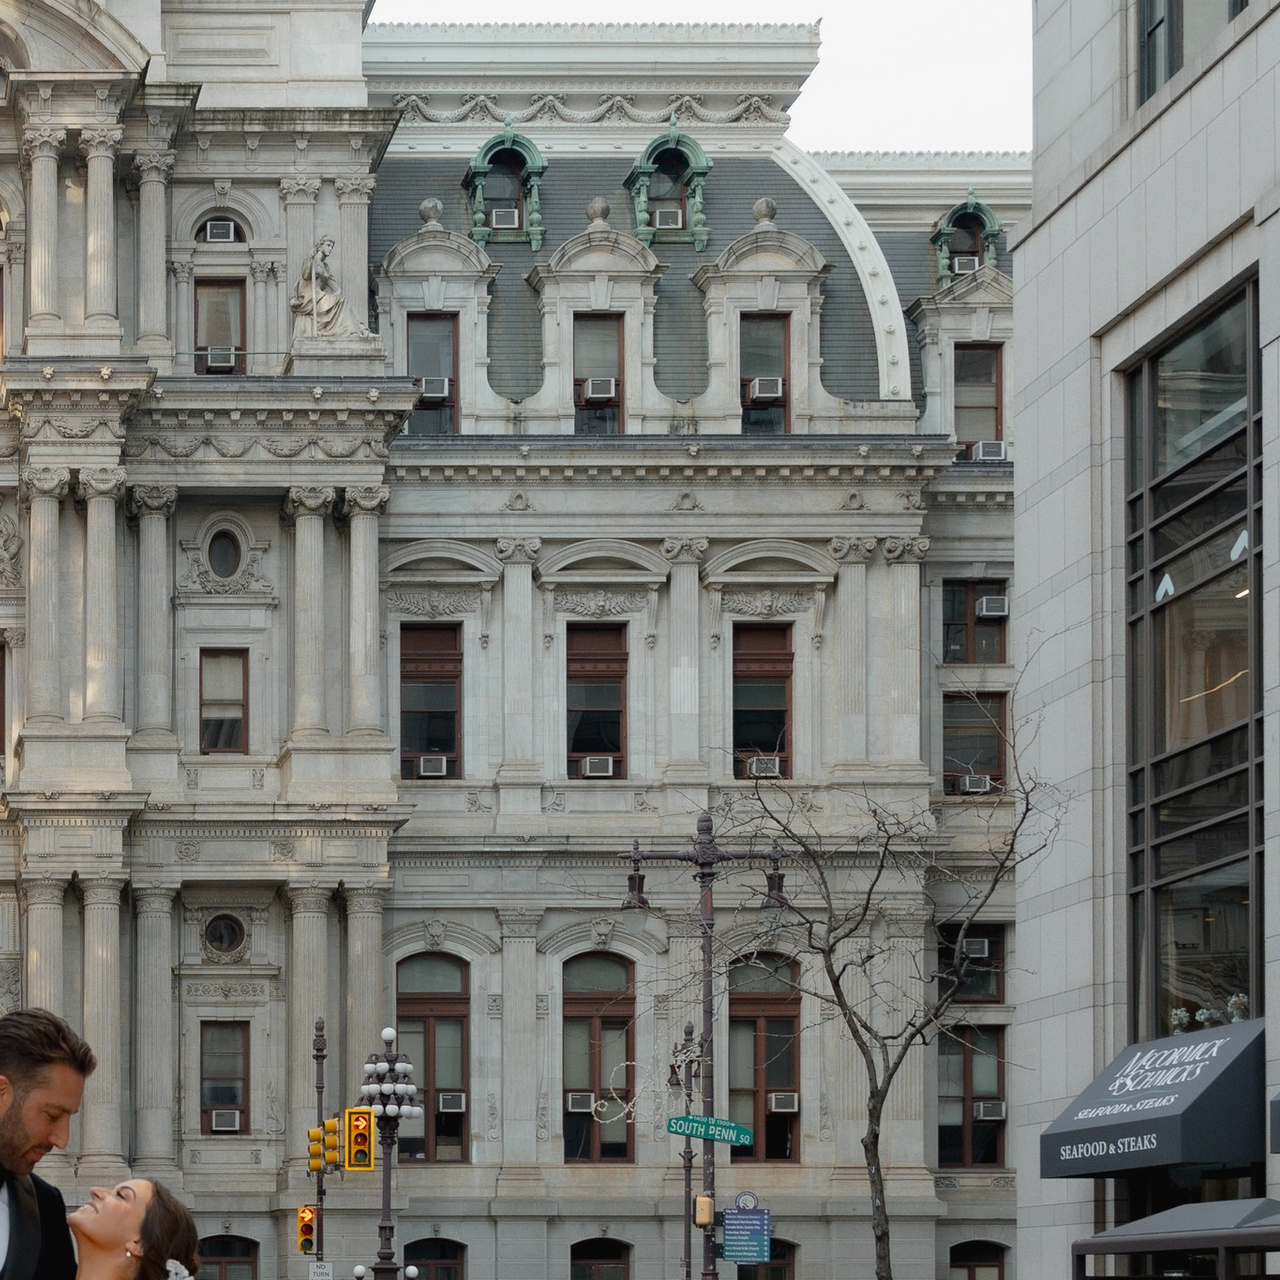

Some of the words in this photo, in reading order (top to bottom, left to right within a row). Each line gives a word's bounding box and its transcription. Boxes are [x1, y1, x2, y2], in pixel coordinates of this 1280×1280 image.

[1074, 1103, 1127, 1120] SEAFOOD
[1132, 1094, 1179, 1111] STEAKS
[669, 1119, 706, 1136] SOUTH
[708, 1125, 737, 1141] PENN
[739, 1134, 750, 1144] SQ
[1060, 1141, 1107, 1160] SEAFOOD
[1109, 1144, 1116, 1154] &
[1117, 1134, 1157, 1154] STEAKS
